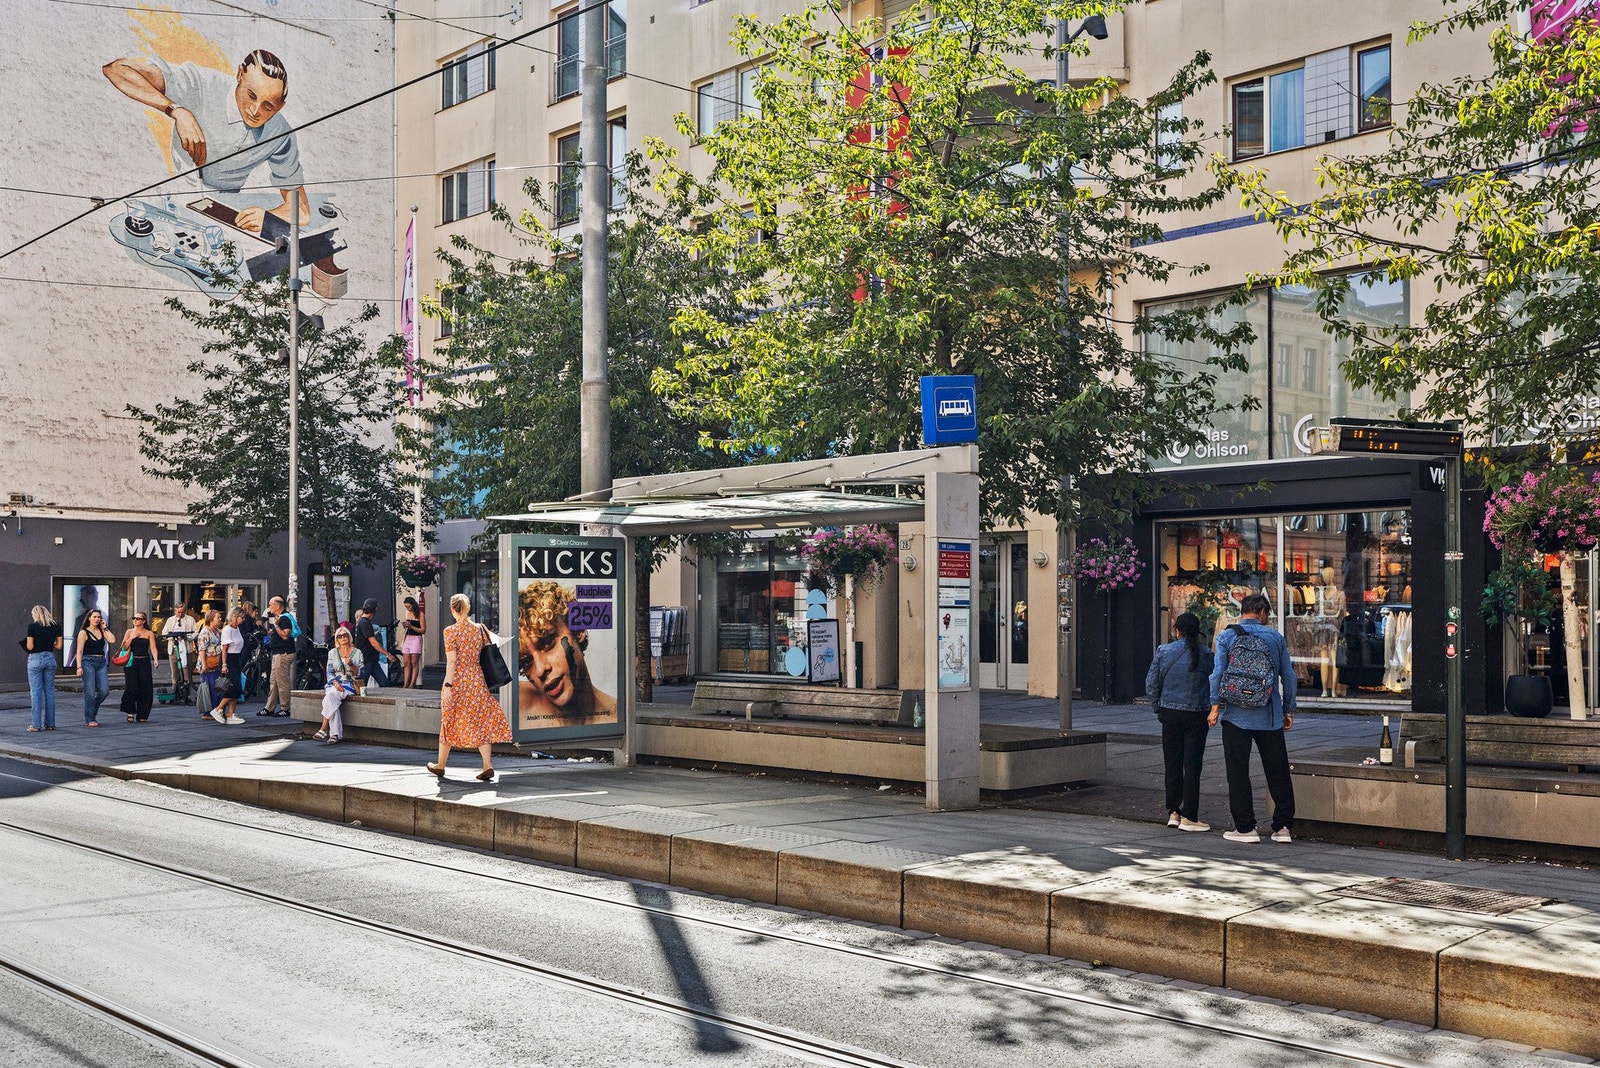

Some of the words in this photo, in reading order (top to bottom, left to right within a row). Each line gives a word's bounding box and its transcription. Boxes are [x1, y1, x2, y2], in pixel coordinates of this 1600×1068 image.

[1194, 443, 1249, 459] Ohlson
[120, 538, 214, 560] MATCH
[521, 550, 613, 575] KICKS
[577, 587, 611, 598] Hudpleie
[570, 604, 611, 627] 25%
